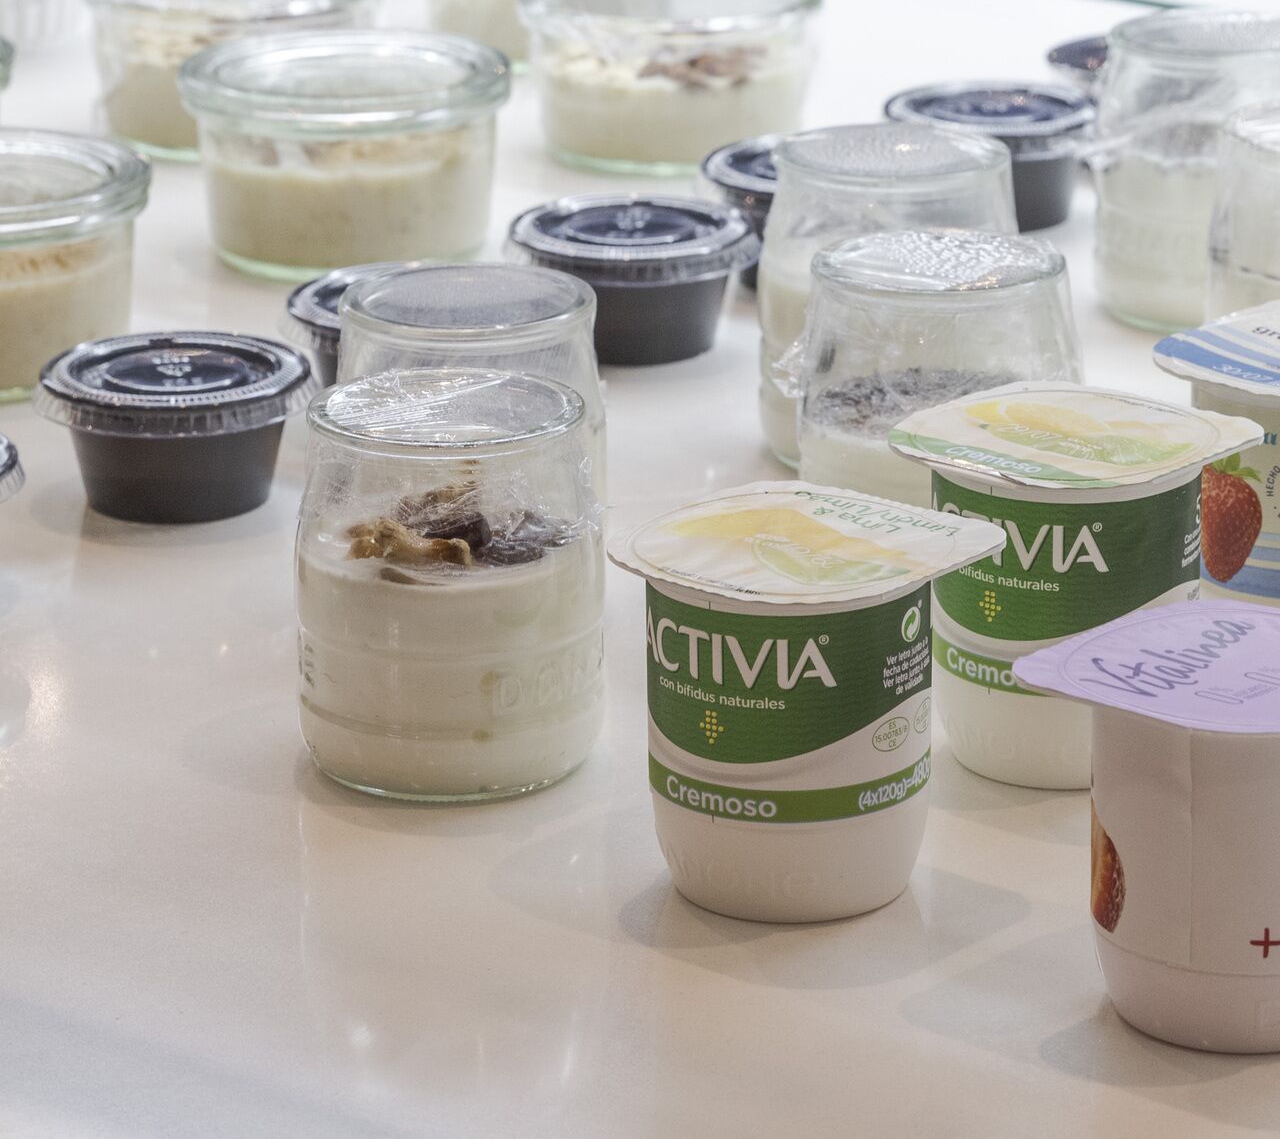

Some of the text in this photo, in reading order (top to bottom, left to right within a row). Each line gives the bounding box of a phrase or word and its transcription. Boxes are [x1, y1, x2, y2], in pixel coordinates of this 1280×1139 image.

[945, 445, 1042, 474] Cremoso
[1266, 465, 1280, 497] HECHO
[839, 513, 901, 533] Lima
[998, 574, 1060, 592] naturales
[646, 606, 838, 690] ACTIVIA
[1079, 619, 1257, 698] Vitalinea
[660, 676, 786, 710] con bífidus naturales
[666, 776, 777, 818] Cremoso
